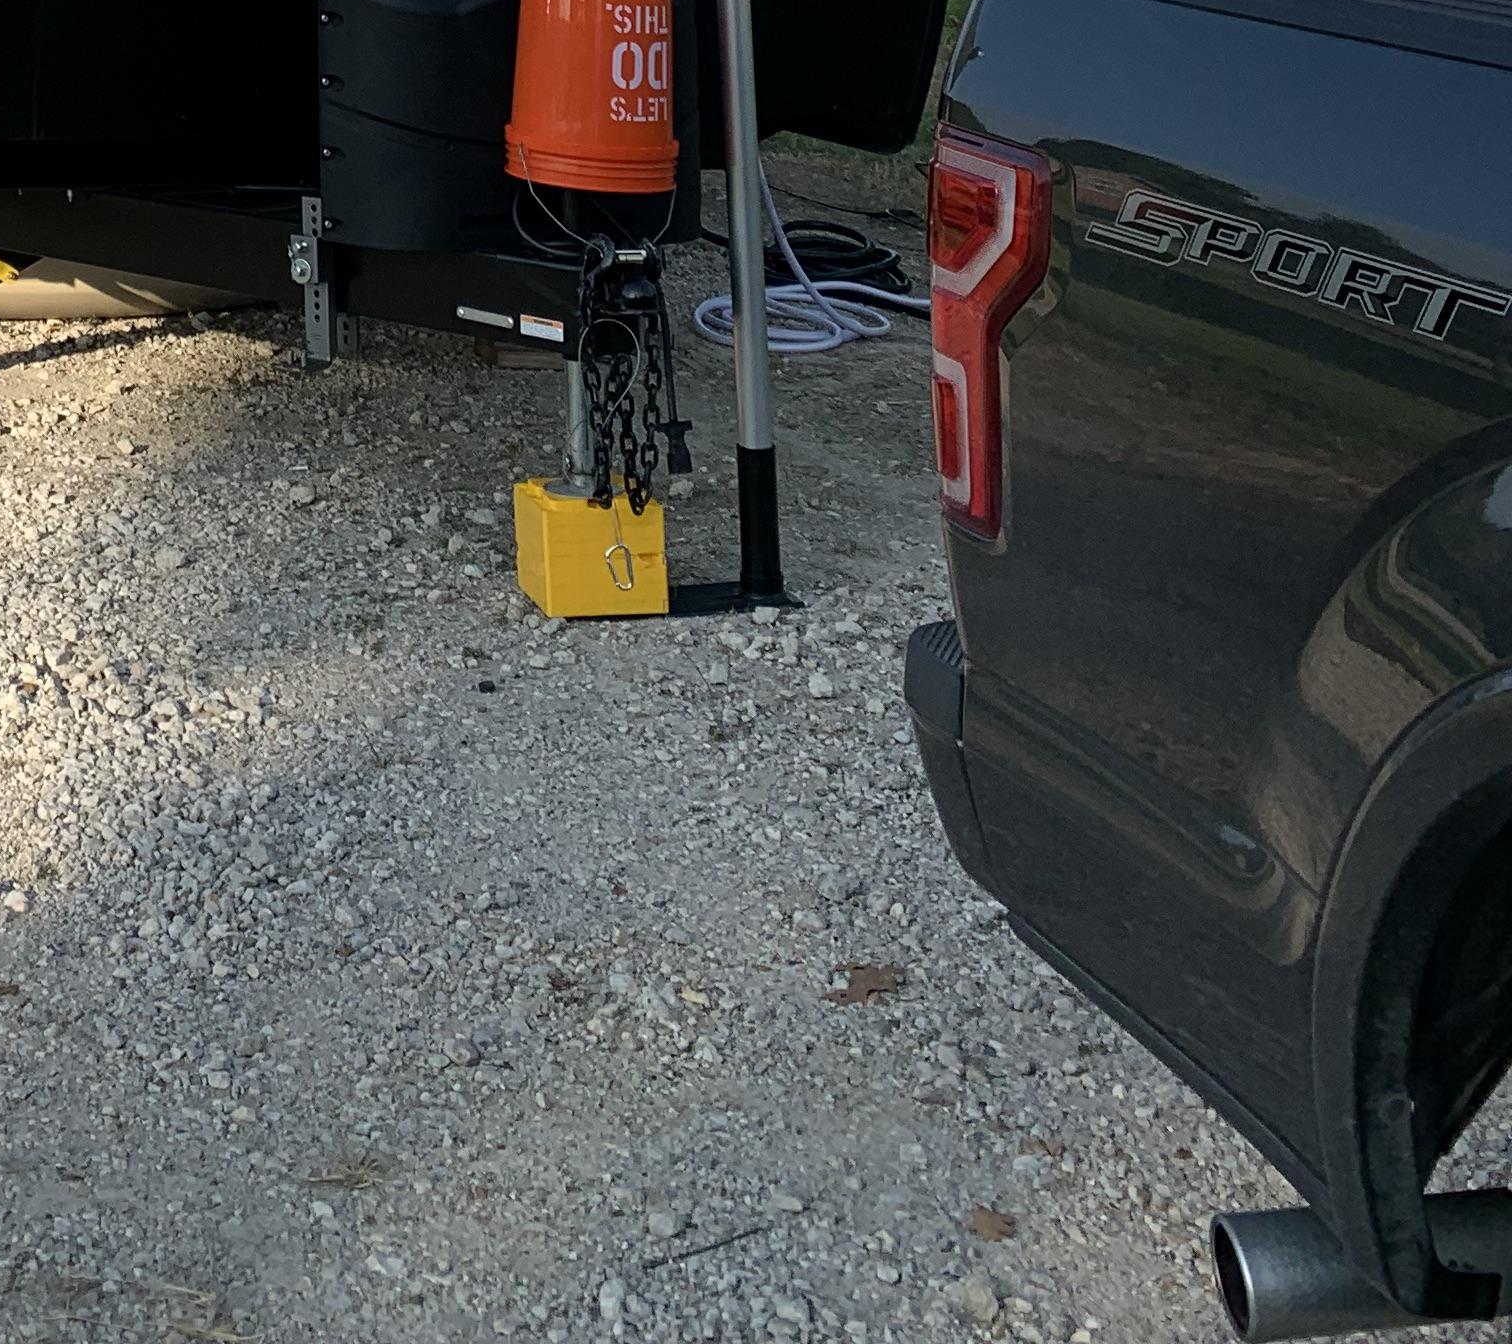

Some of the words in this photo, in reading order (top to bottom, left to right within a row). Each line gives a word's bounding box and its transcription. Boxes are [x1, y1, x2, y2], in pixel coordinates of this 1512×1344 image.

[605, 2, 668, 35] THIS.
[611, 40, 668, 91] DO
[609, 95, 668, 123] LET'S
[1085, 188, 1512, 341] SPORT
